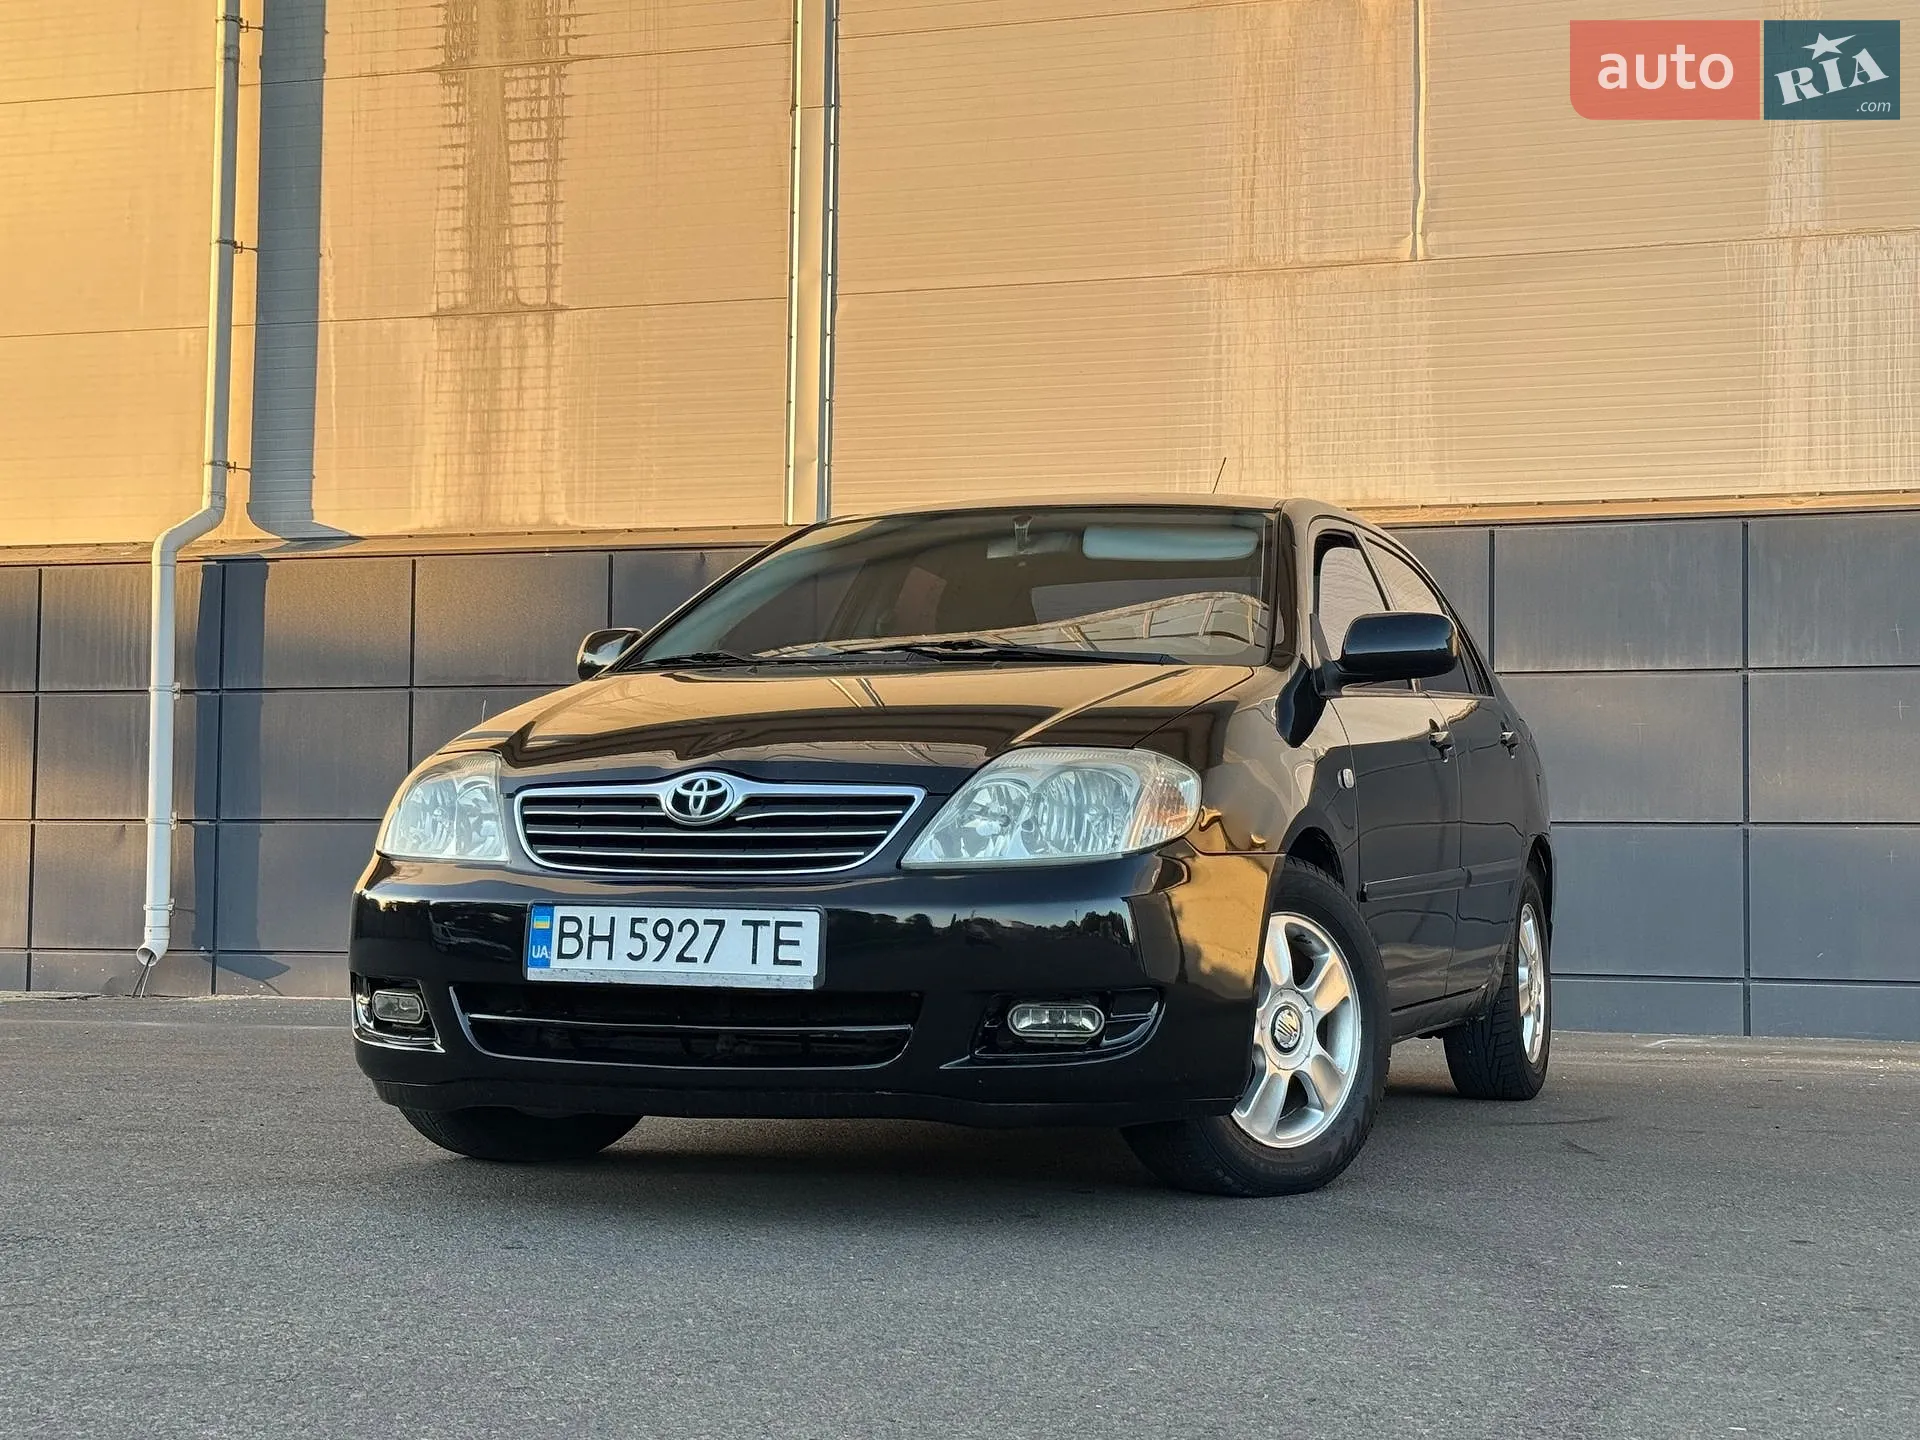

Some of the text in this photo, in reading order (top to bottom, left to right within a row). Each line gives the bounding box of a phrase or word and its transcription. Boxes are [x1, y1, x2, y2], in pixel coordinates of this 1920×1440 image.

[532, 944, 549, 958] UA
[556, 915, 803, 967] BH 5927 TE
